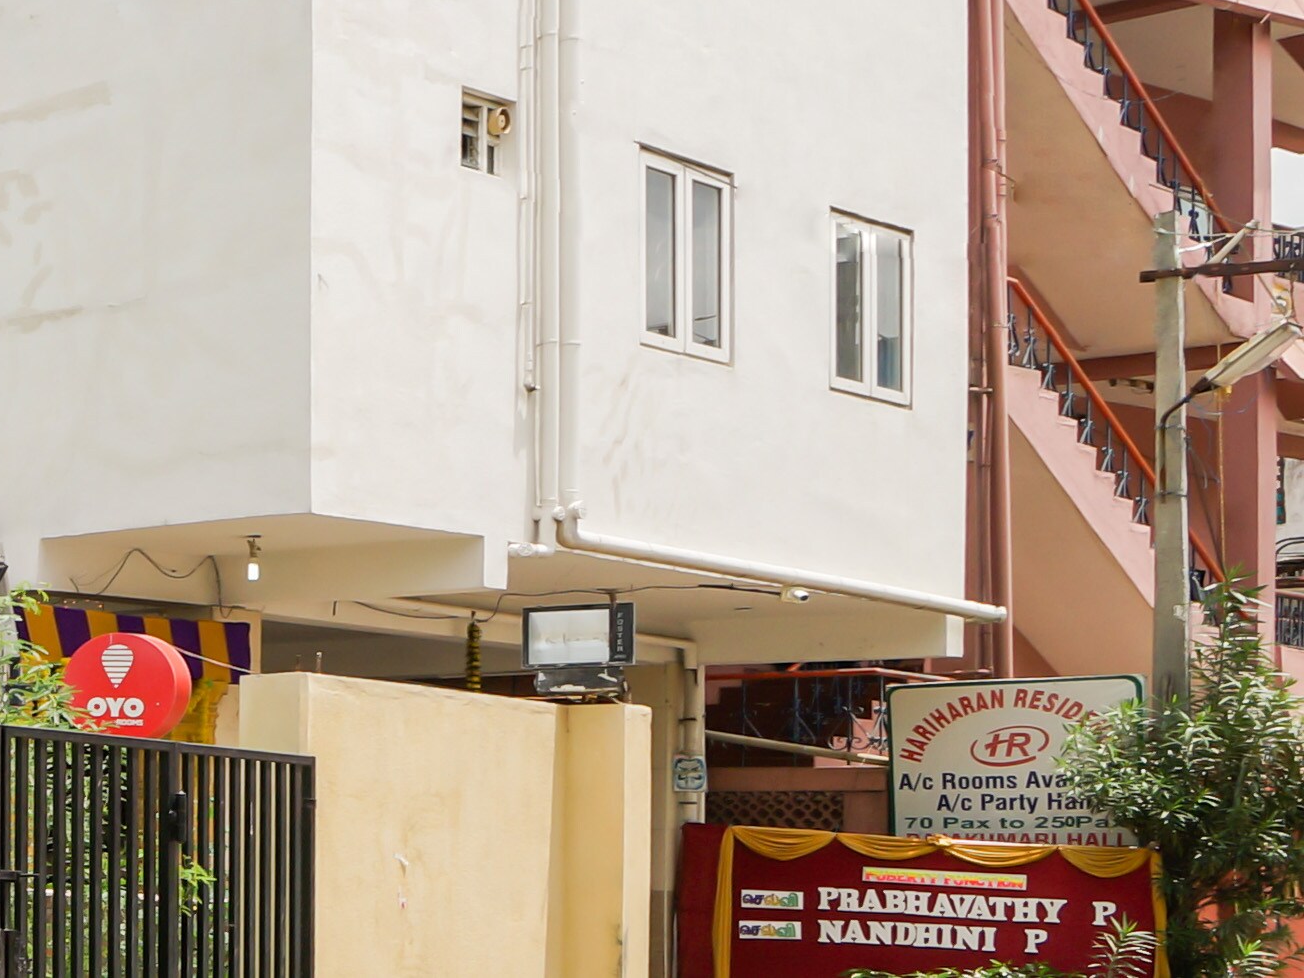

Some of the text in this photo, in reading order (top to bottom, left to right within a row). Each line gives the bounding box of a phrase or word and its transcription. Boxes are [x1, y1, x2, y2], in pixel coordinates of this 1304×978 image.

[87, 697, 145, 718] OYO
[899, 689, 1004, 763] HARIHARAN
[985, 733, 1032, 758] HR
[898, 773, 934, 792] A/c
[942, 773, 1018, 790] Rooms
[937, 793, 972, 812] A/c
[982, 795, 1039, 814] Party
[904, 817, 934, 829] 70
[943, 818, 990, 829] Pax
[1000, 817, 1025, 829] to
[817, 887, 1117, 926] PRABHAVATHY P
[817, 919, 1048, 953] NANDHINI P
